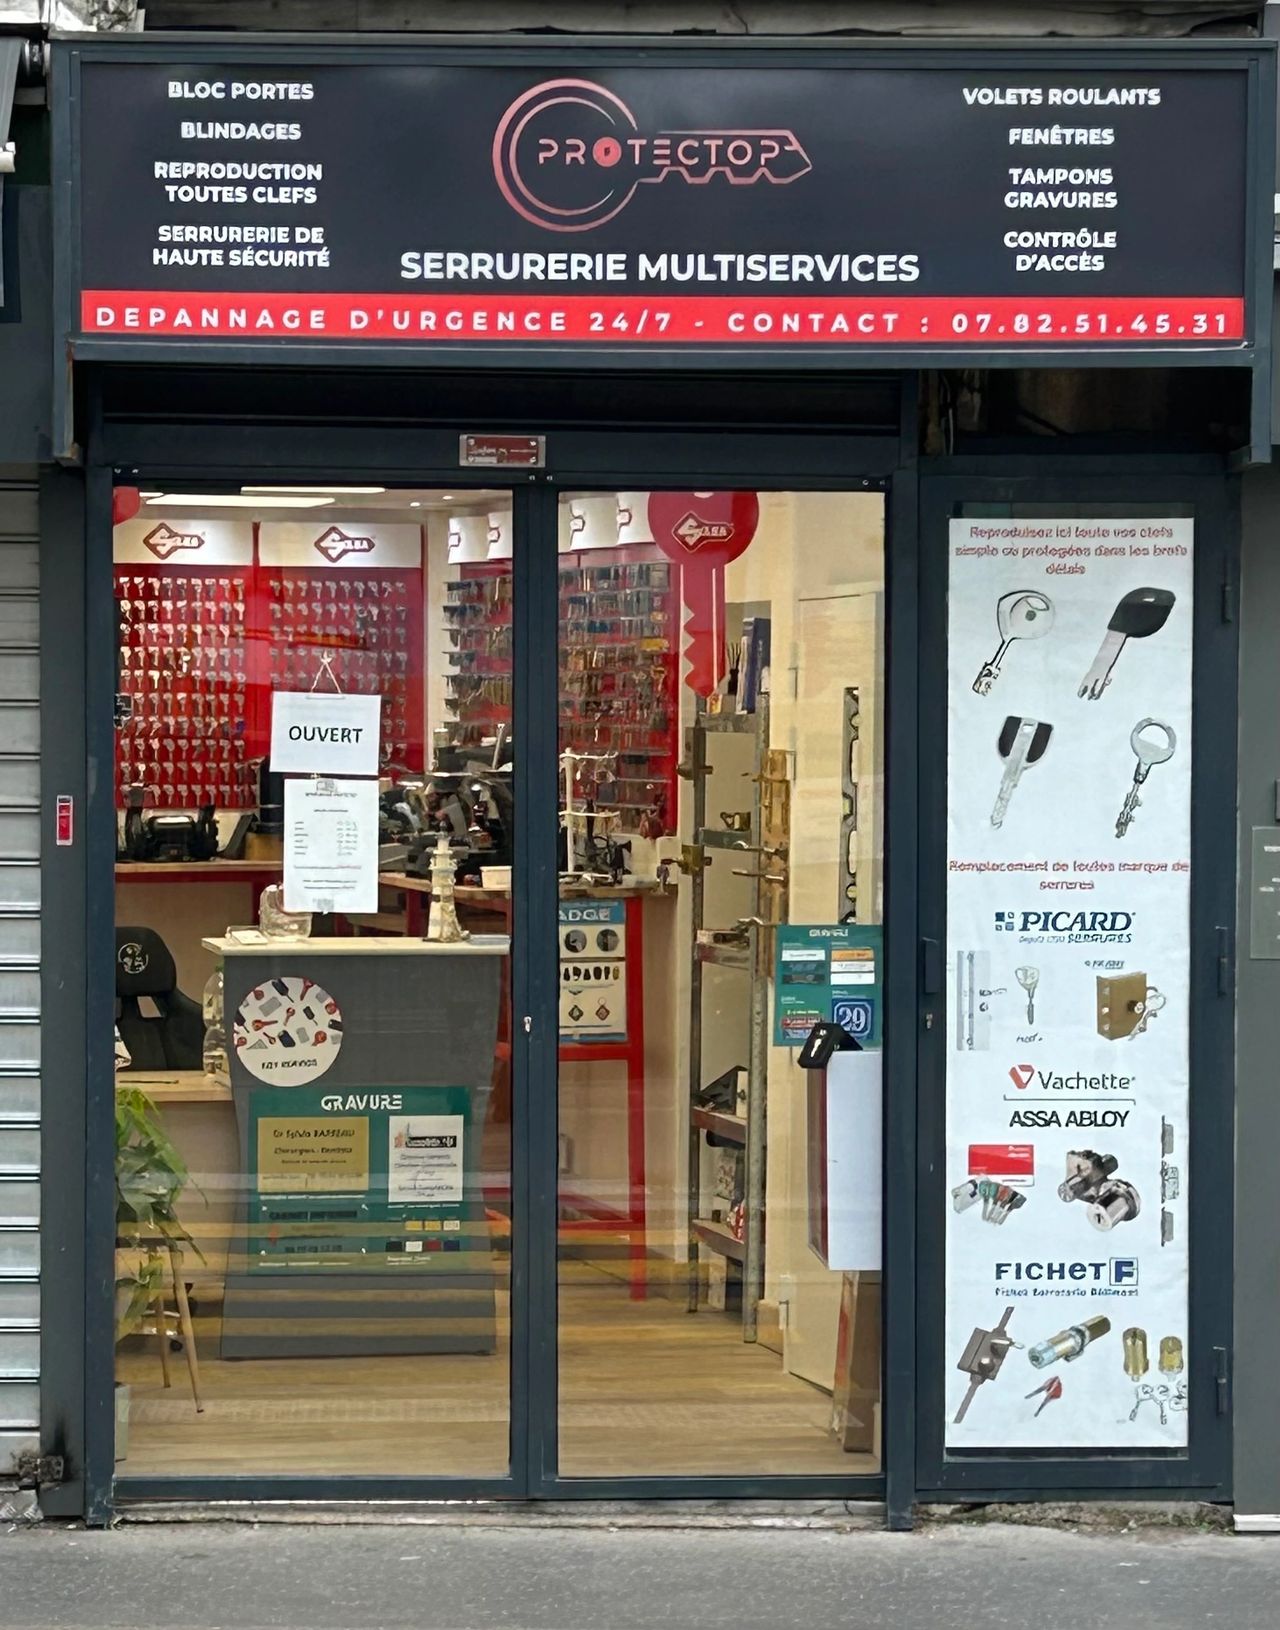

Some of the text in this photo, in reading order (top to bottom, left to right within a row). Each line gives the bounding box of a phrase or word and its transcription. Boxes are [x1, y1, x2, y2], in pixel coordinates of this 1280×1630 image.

[169, 82, 313, 99] BLOC PORTES
[963, 88, 1160, 105] VOLETS ROULANTS
[181, 122, 301, 140] BLINDAGES
[1009, 125, 1114, 144] FENÊTRES
[155, 162, 322, 180] REPRODUCTION
[1009, 168, 1113, 184] TAMPONS
[165, 185, 317, 203] TOUTES CLEFS
[1004, 192, 1117, 208] GRAVURES
[159, 225, 324, 243] SERRURERIE DE
[1004, 228, 1116, 248] CONTRÔLE
[153, 246, 329, 267] HAUTE SÉCURITÉ
[1016, 251, 1104, 271] D'ACCÈS
[401, 252, 919, 281] SERRURERIE MULTISERVICES
[97, 308, 324, 328] DEPANNAGE
[351, 310, 565, 330] D'URGENCE
[590, 310, 670, 333] 24/7
[728, 313, 897, 332] CONTACT
[953, 314, 1224, 333] 07.82.51.45.31
[288, 724, 364, 745] OUVERT
[1018, 911, 1132, 932] PICARD
[1037, 1071, 1131, 1090] Vachette
[321, 1095, 402, 1111] GRAVURE
[1009, 1110, 1130, 1128] ASSA ABLOY
